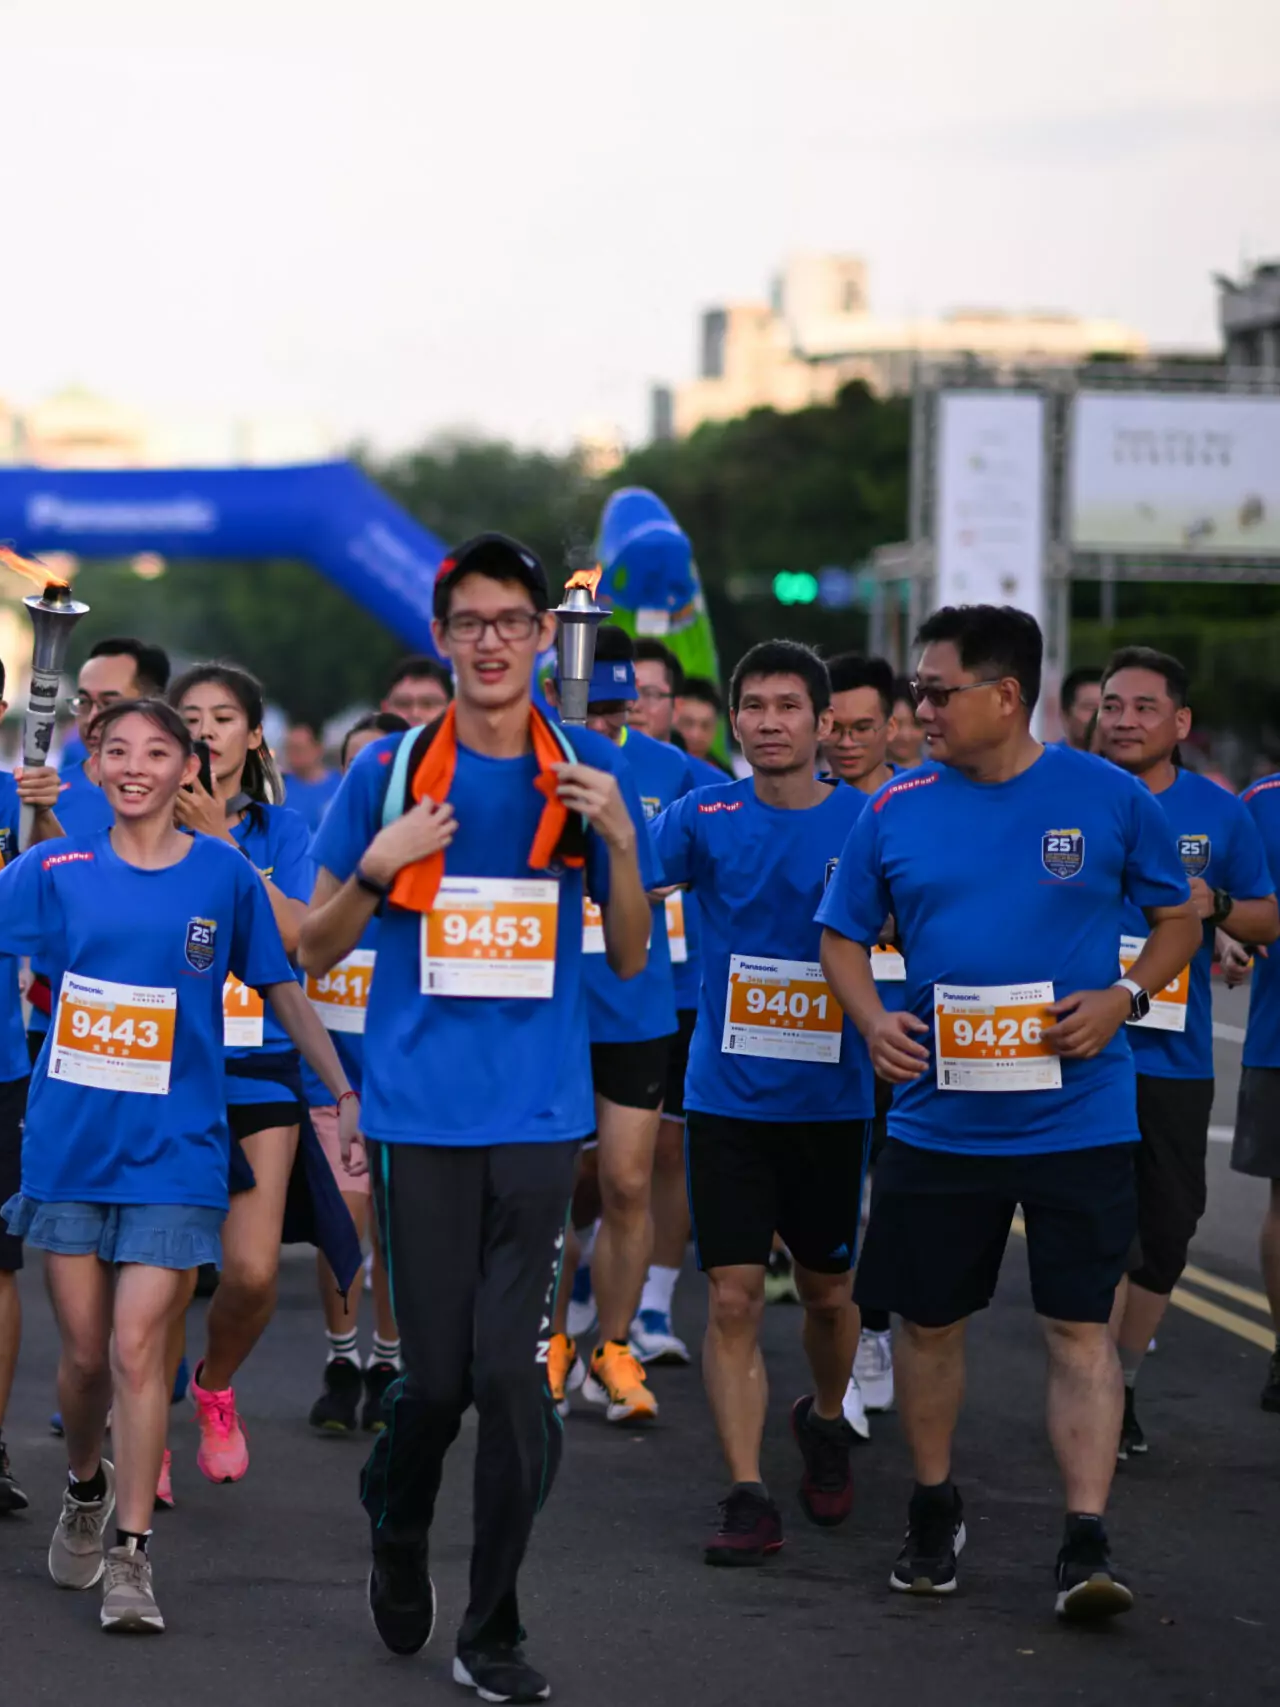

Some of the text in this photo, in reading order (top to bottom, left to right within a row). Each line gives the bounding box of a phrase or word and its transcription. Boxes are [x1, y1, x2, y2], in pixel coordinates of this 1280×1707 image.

[1048, 838, 1070, 852] 25
[1181, 842, 1200, 855] 25
[192, 926, 210, 944] 25
[443, 914, 542, 947] 9453
[740, 962, 778, 973] Panasonic
[69, 981, 104, 995] Panasonic
[746, 988, 827, 1020] 9401
[943, 992, 980, 1001] Panasonic
[72, 1010, 159, 1048] 9443
[953, 1017, 1042, 1046] 9426
